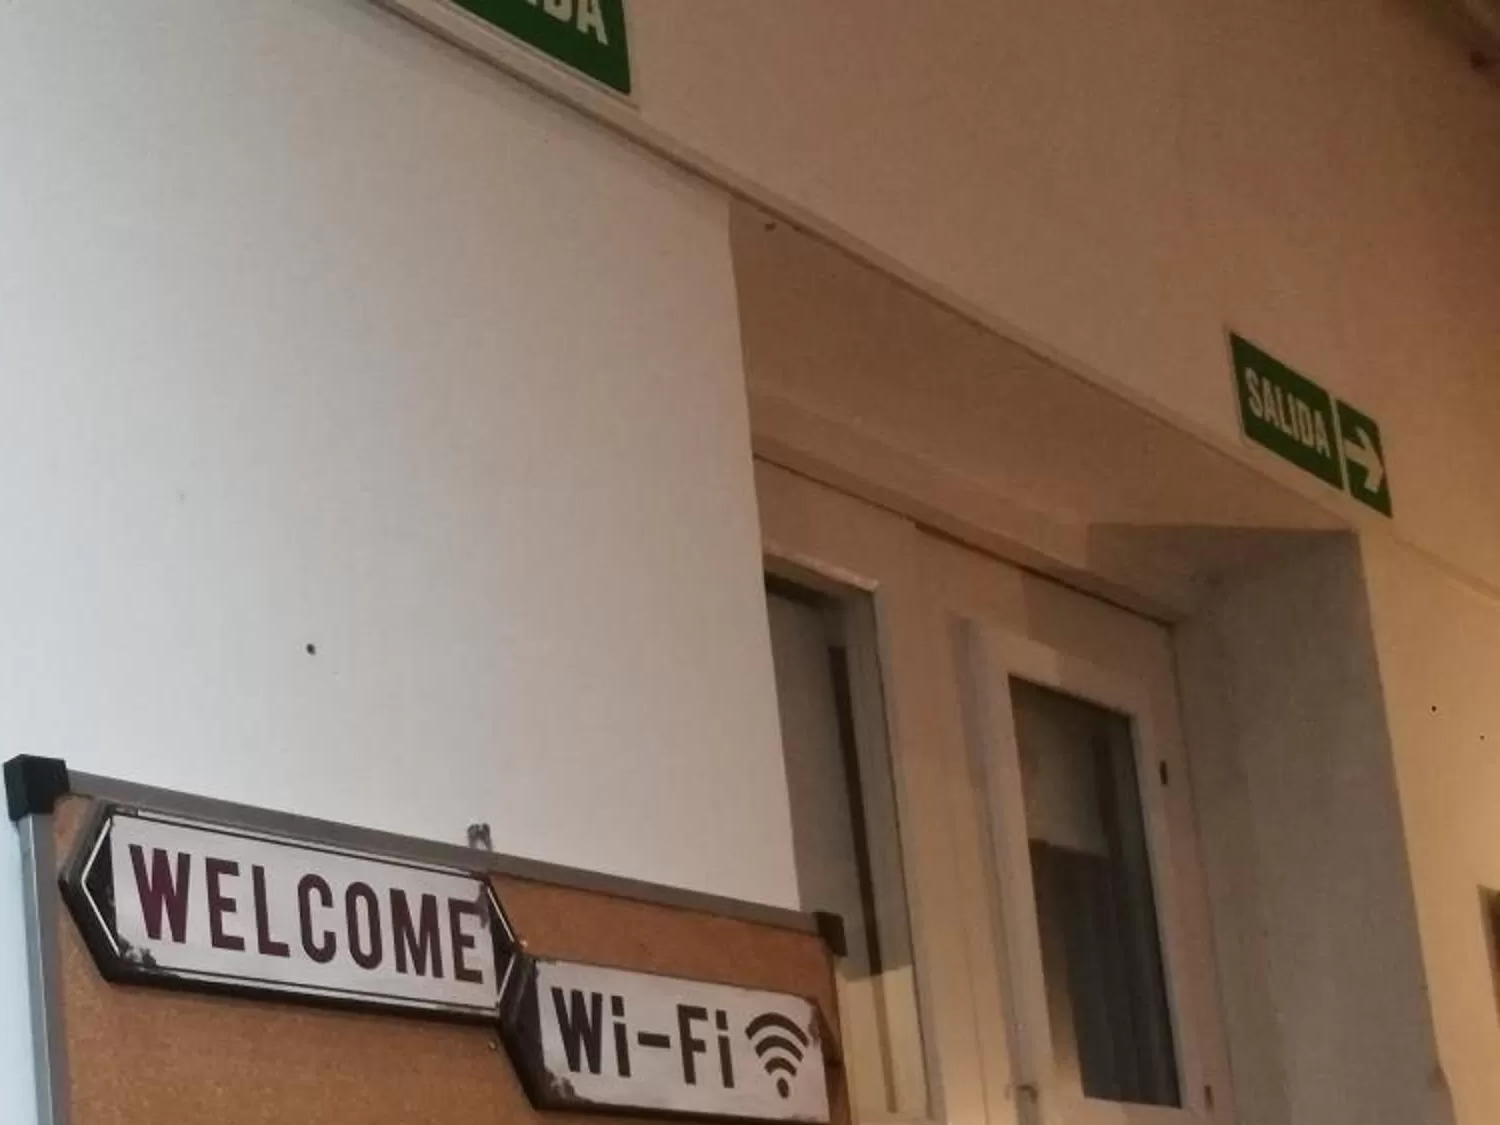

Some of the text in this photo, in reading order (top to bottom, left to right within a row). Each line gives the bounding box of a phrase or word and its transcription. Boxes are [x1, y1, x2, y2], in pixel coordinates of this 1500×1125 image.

[1245, 367, 1330, 458] SALIDA
[127, 843, 485, 985] WELCOME
[551, 985, 736, 1090] Wi-Fi
